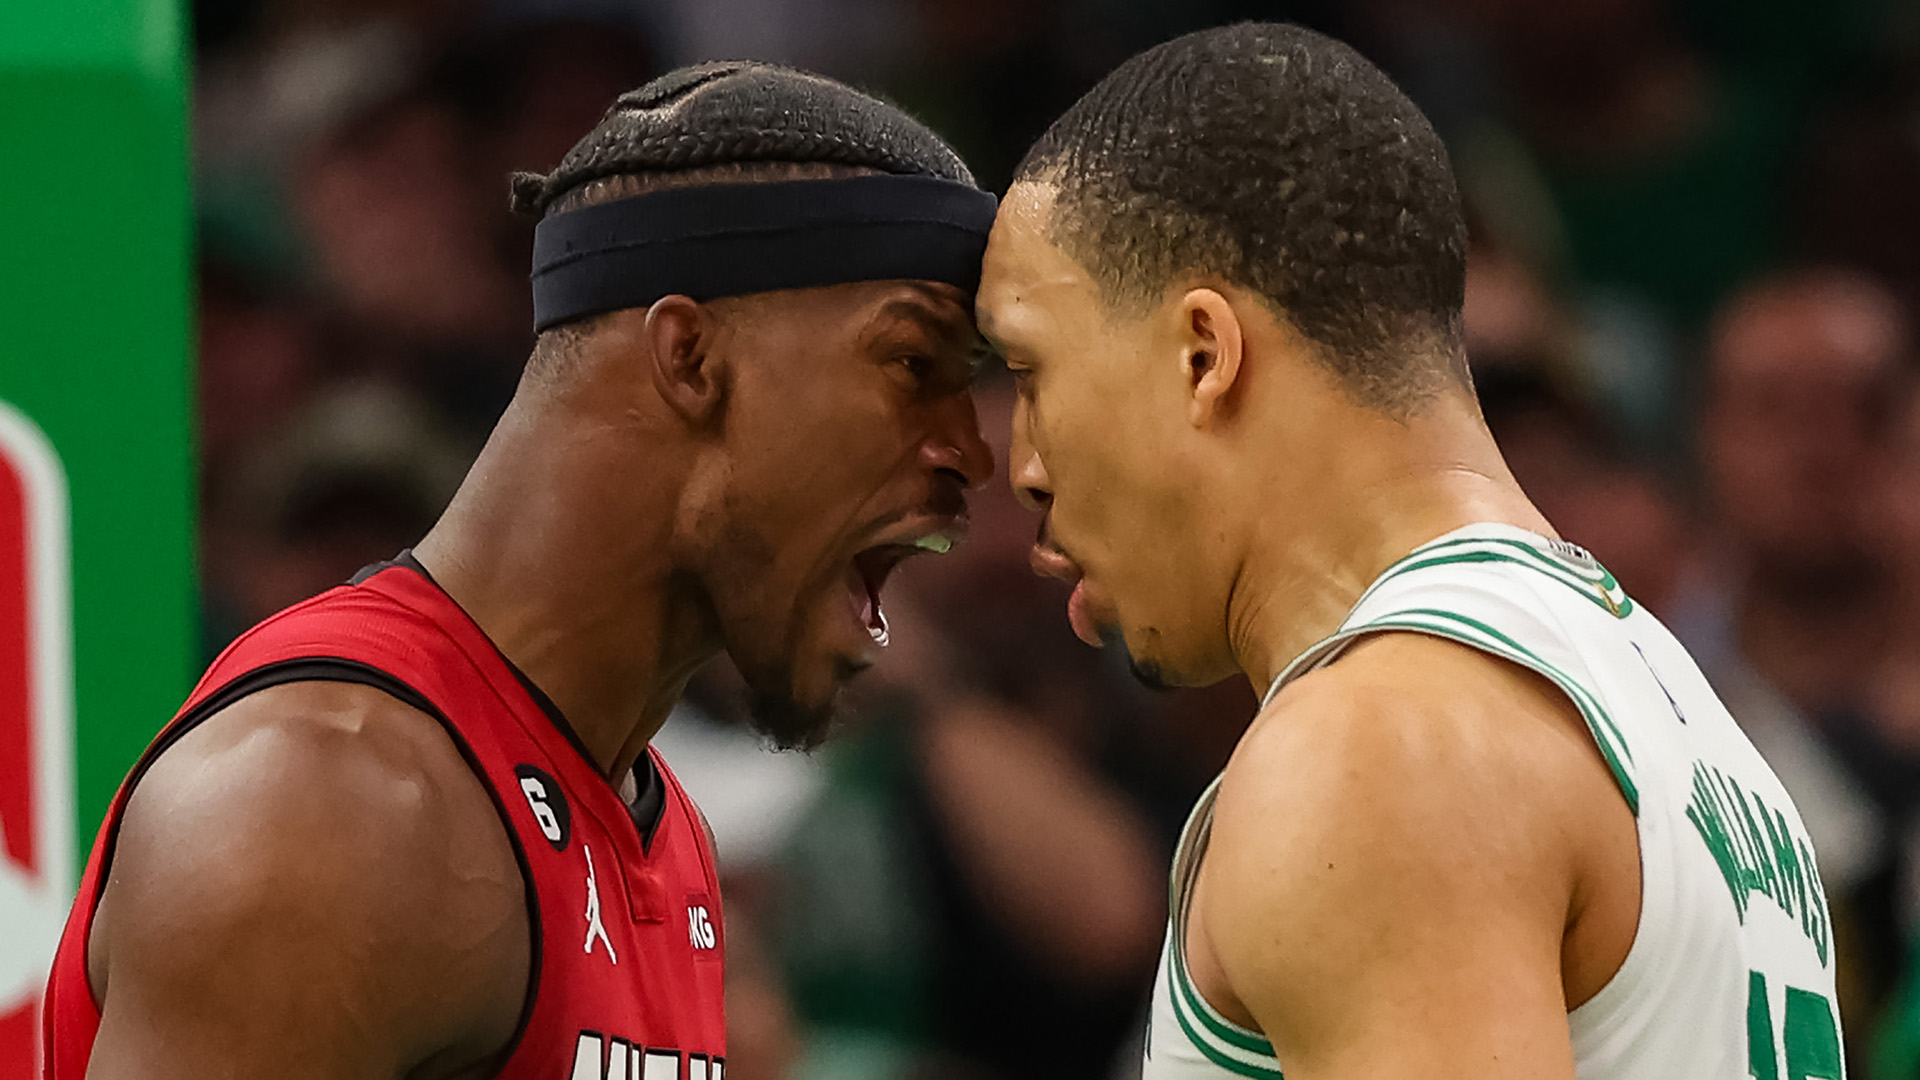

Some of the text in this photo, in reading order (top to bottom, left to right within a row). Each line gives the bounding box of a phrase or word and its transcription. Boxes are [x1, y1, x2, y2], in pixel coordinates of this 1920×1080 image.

[519, 776, 562, 842] 6
[1685, 758, 1828, 970] WILLIAMS
[687, 906, 716, 949] KG
